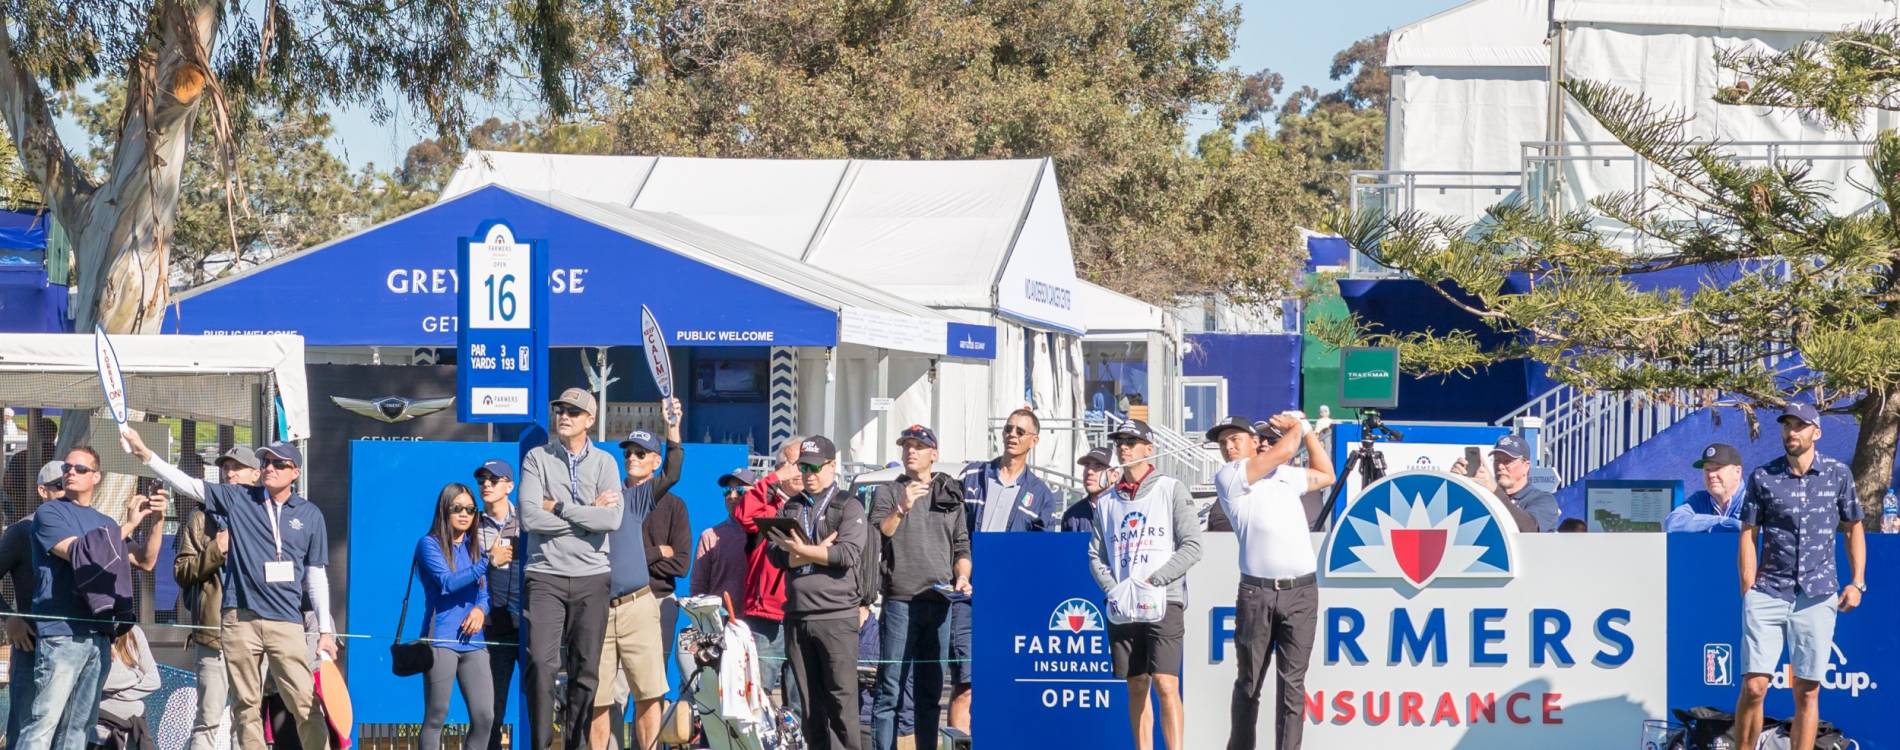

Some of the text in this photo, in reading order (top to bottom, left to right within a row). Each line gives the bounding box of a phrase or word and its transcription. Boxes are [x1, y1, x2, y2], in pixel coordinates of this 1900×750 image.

[485, 274, 516, 322] 16
[677, 331, 774, 341] PUBLIC WELCOME
[471, 344, 506, 357] PAR 3
[648, 334, 665, 376] CALM
[470, 357, 497, 369] YARDS
[501, 358, 515, 370] 193
[1111, 527, 1165, 543] ARMERS
[1014, 635, 1111, 654] FARME
[1209, 606, 1635, 669] FRMERS
[1034, 661, 1113, 672] INSURANC
[1041, 688, 1110, 708] OPEN
[1302, 689, 1563, 727] NSURANCE
